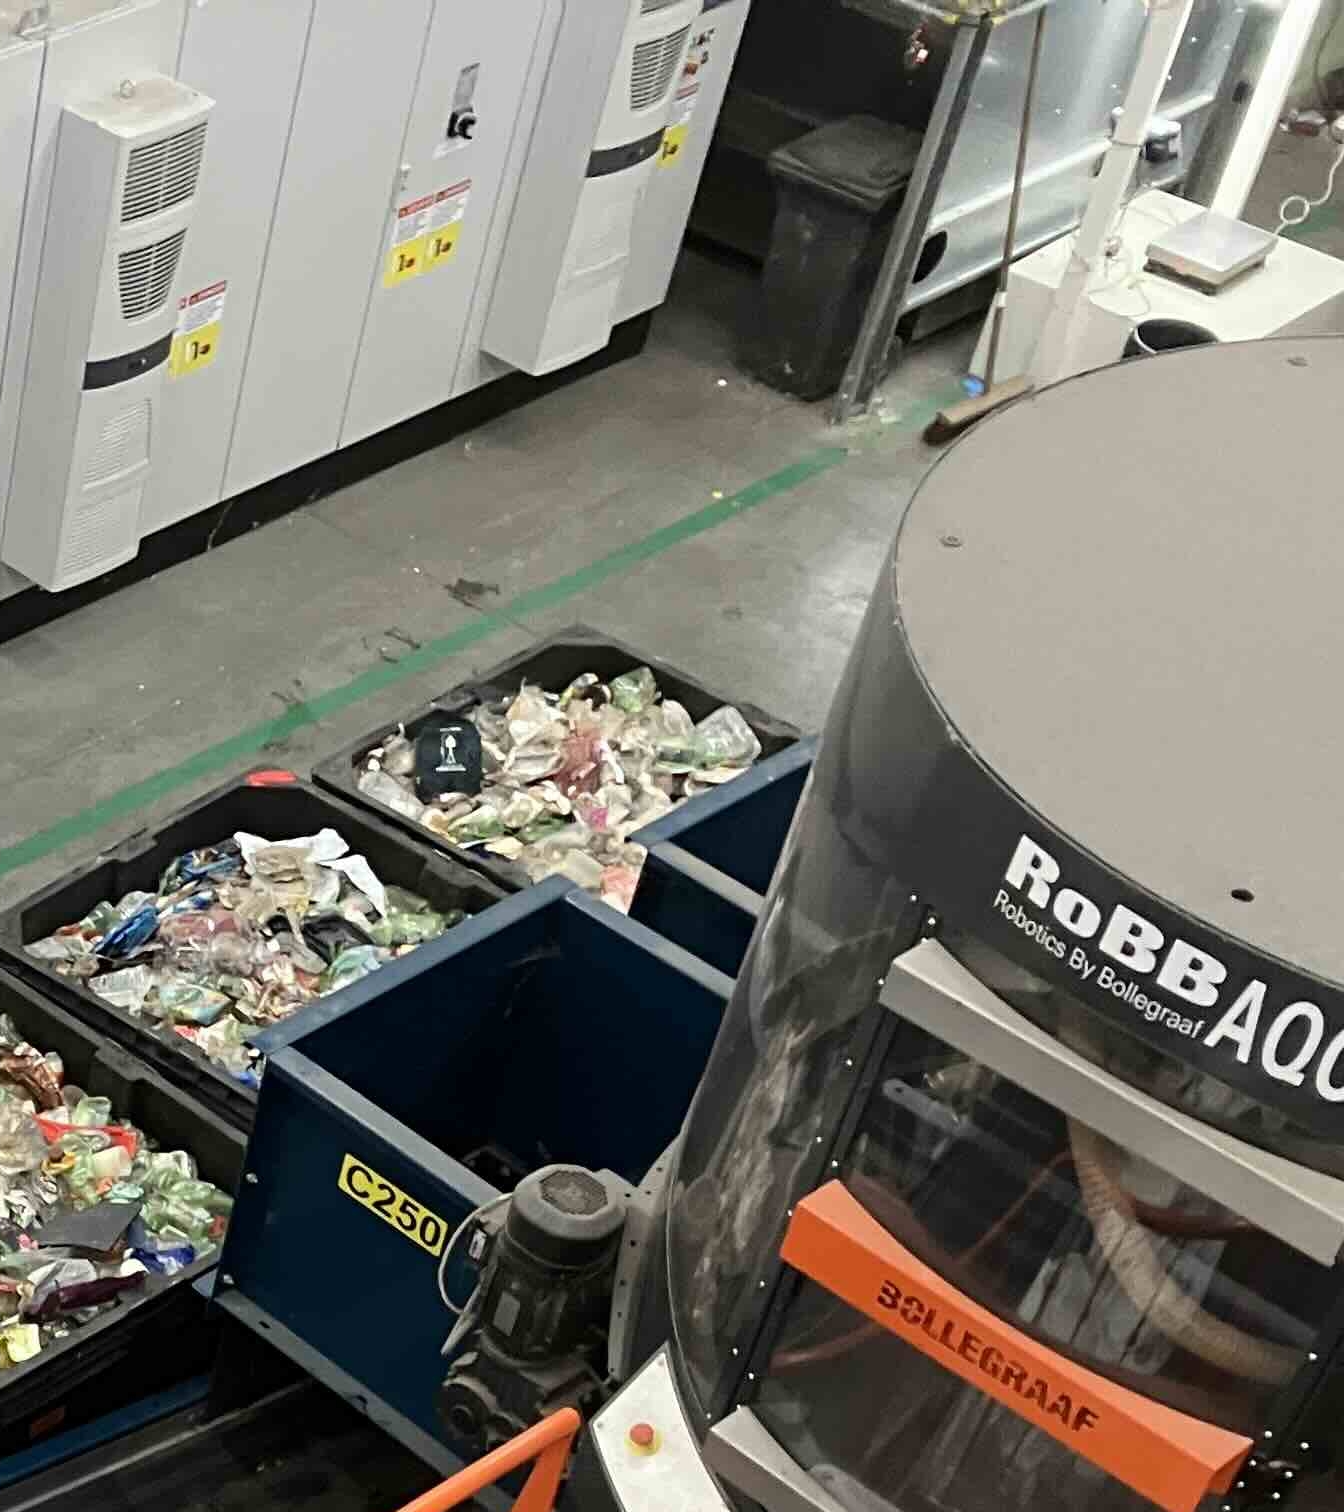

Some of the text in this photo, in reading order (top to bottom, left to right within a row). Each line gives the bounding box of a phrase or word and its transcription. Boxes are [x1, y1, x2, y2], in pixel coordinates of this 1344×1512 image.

[993, 888, 1207, 1039] Robotics By Bollegraaf
[346, 1165, 441, 1247] C250
[876, 1279, 1100, 1432] BOLLEGRAAF
